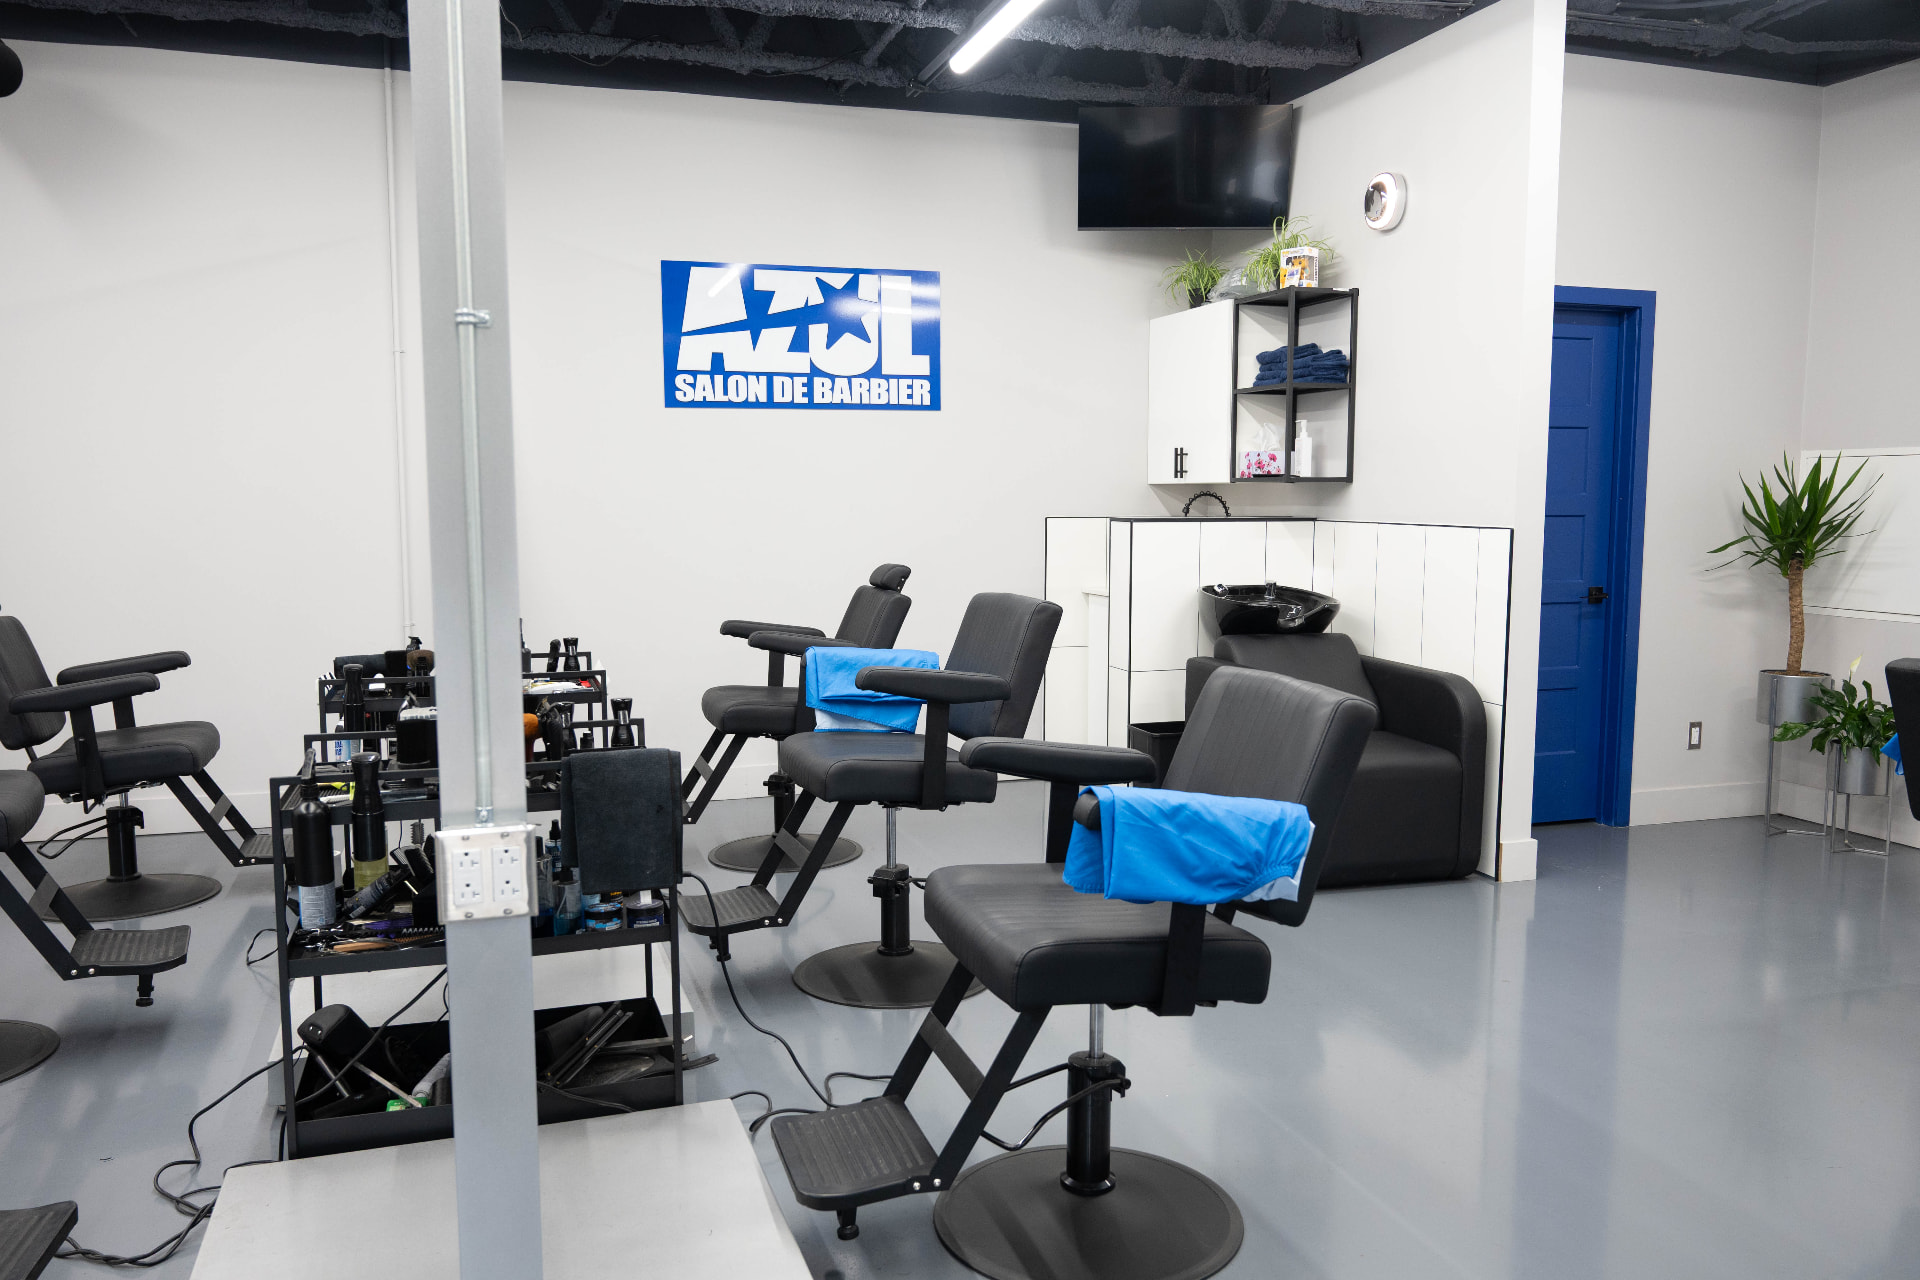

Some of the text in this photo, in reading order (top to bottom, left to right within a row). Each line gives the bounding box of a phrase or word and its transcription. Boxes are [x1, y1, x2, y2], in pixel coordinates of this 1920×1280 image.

[677, 266, 930, 376] AZUL
[675, 374, 931, 406] SALON DE BARBIER
